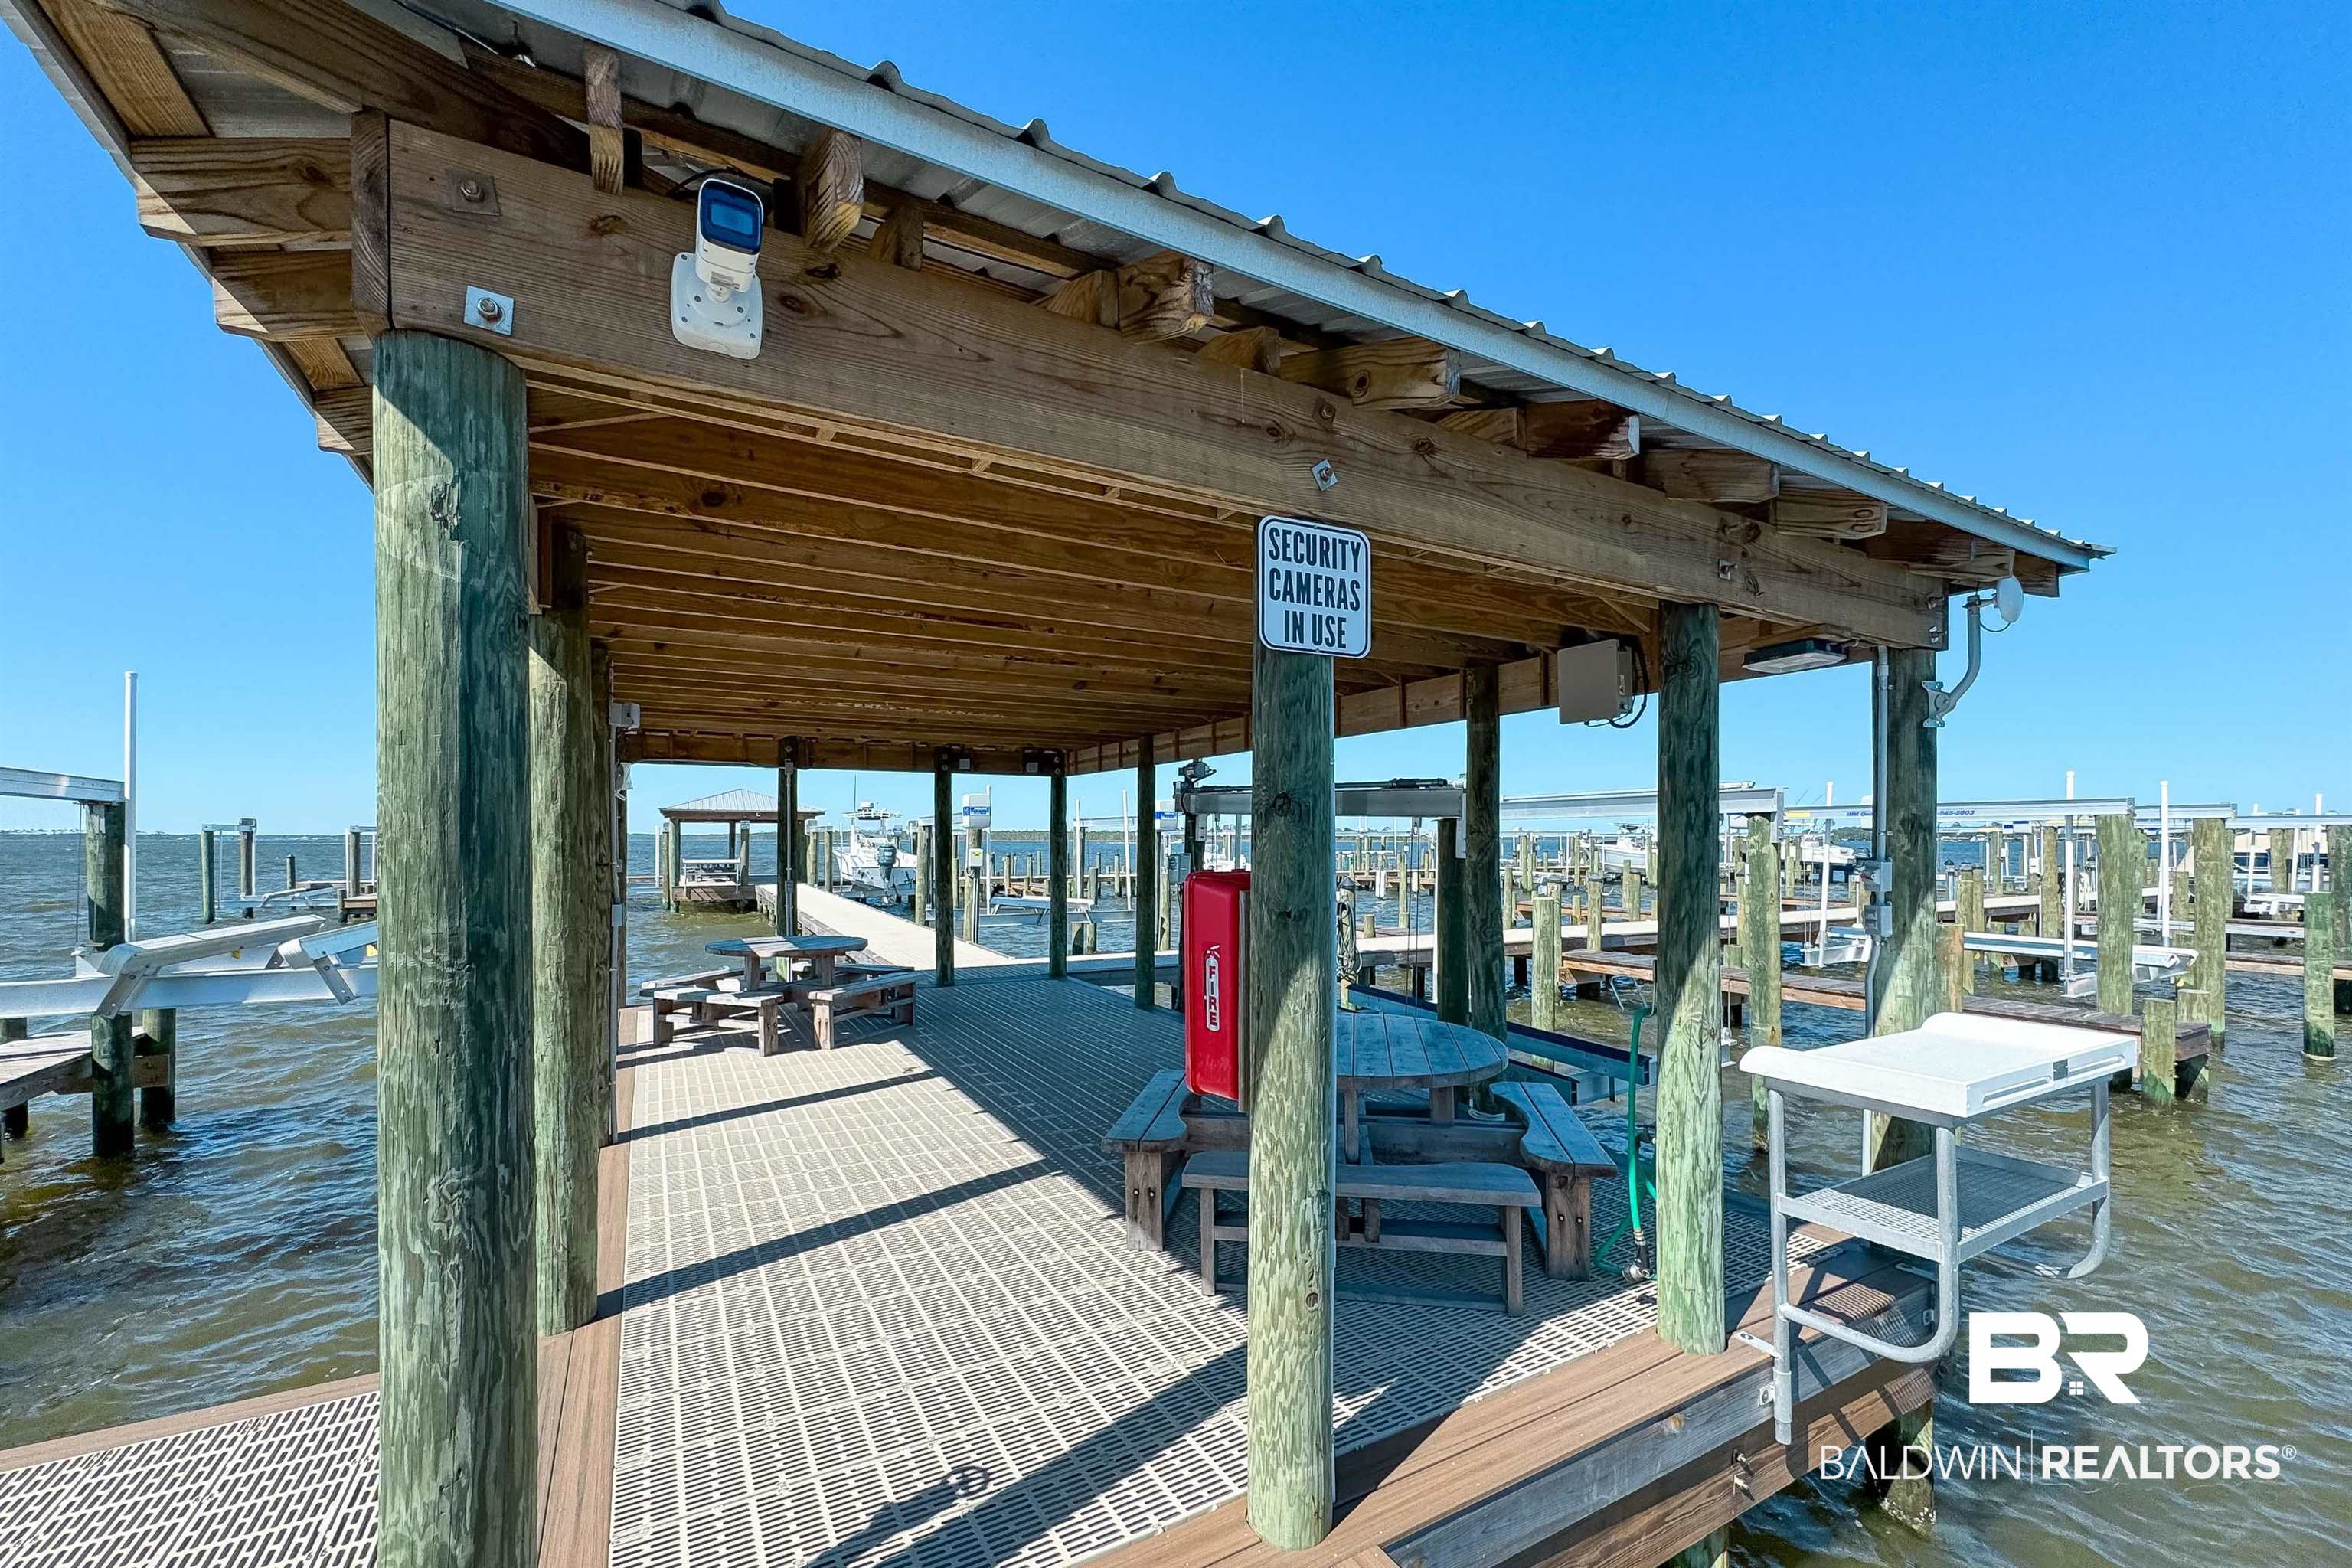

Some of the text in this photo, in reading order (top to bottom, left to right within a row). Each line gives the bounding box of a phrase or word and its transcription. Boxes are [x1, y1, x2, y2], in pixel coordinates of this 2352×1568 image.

[1269, 528, 1361, 572] SECURITY
[1269, 567, 1360, 611] CAMERAS
[1284, 610, 1347, 648] IN USE
[1208, 965, 1217, 1026] FIRE
